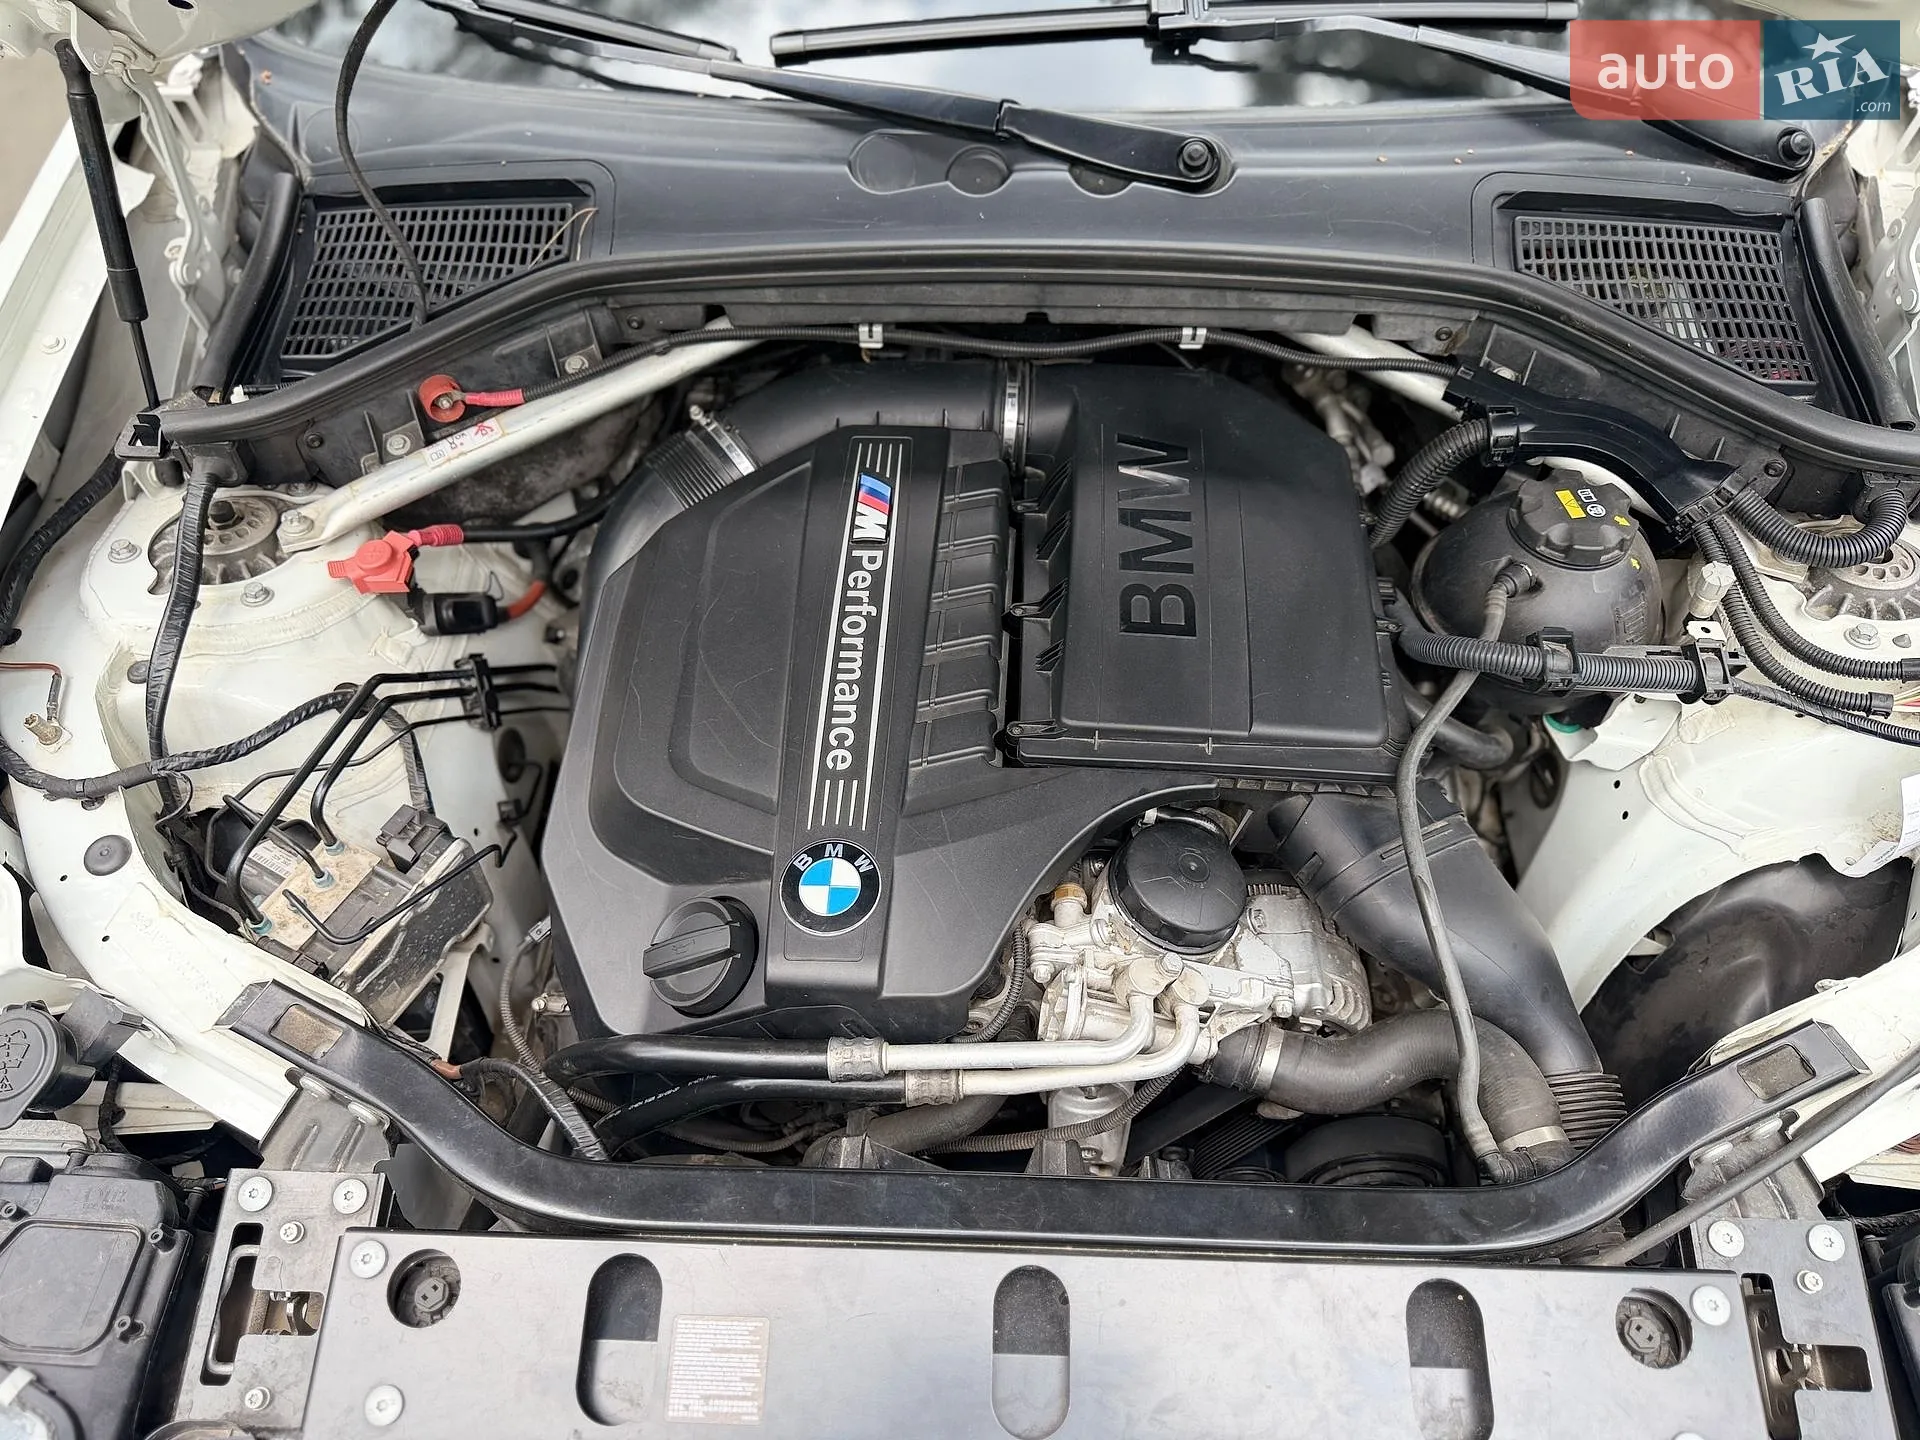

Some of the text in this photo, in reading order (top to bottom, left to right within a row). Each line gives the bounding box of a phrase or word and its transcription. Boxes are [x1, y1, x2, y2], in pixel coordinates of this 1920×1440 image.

[825, 499, 891, 772] M Performance
[1115, 432, 1198, 638] BMW
[793, 843, 875, 873] BMW
